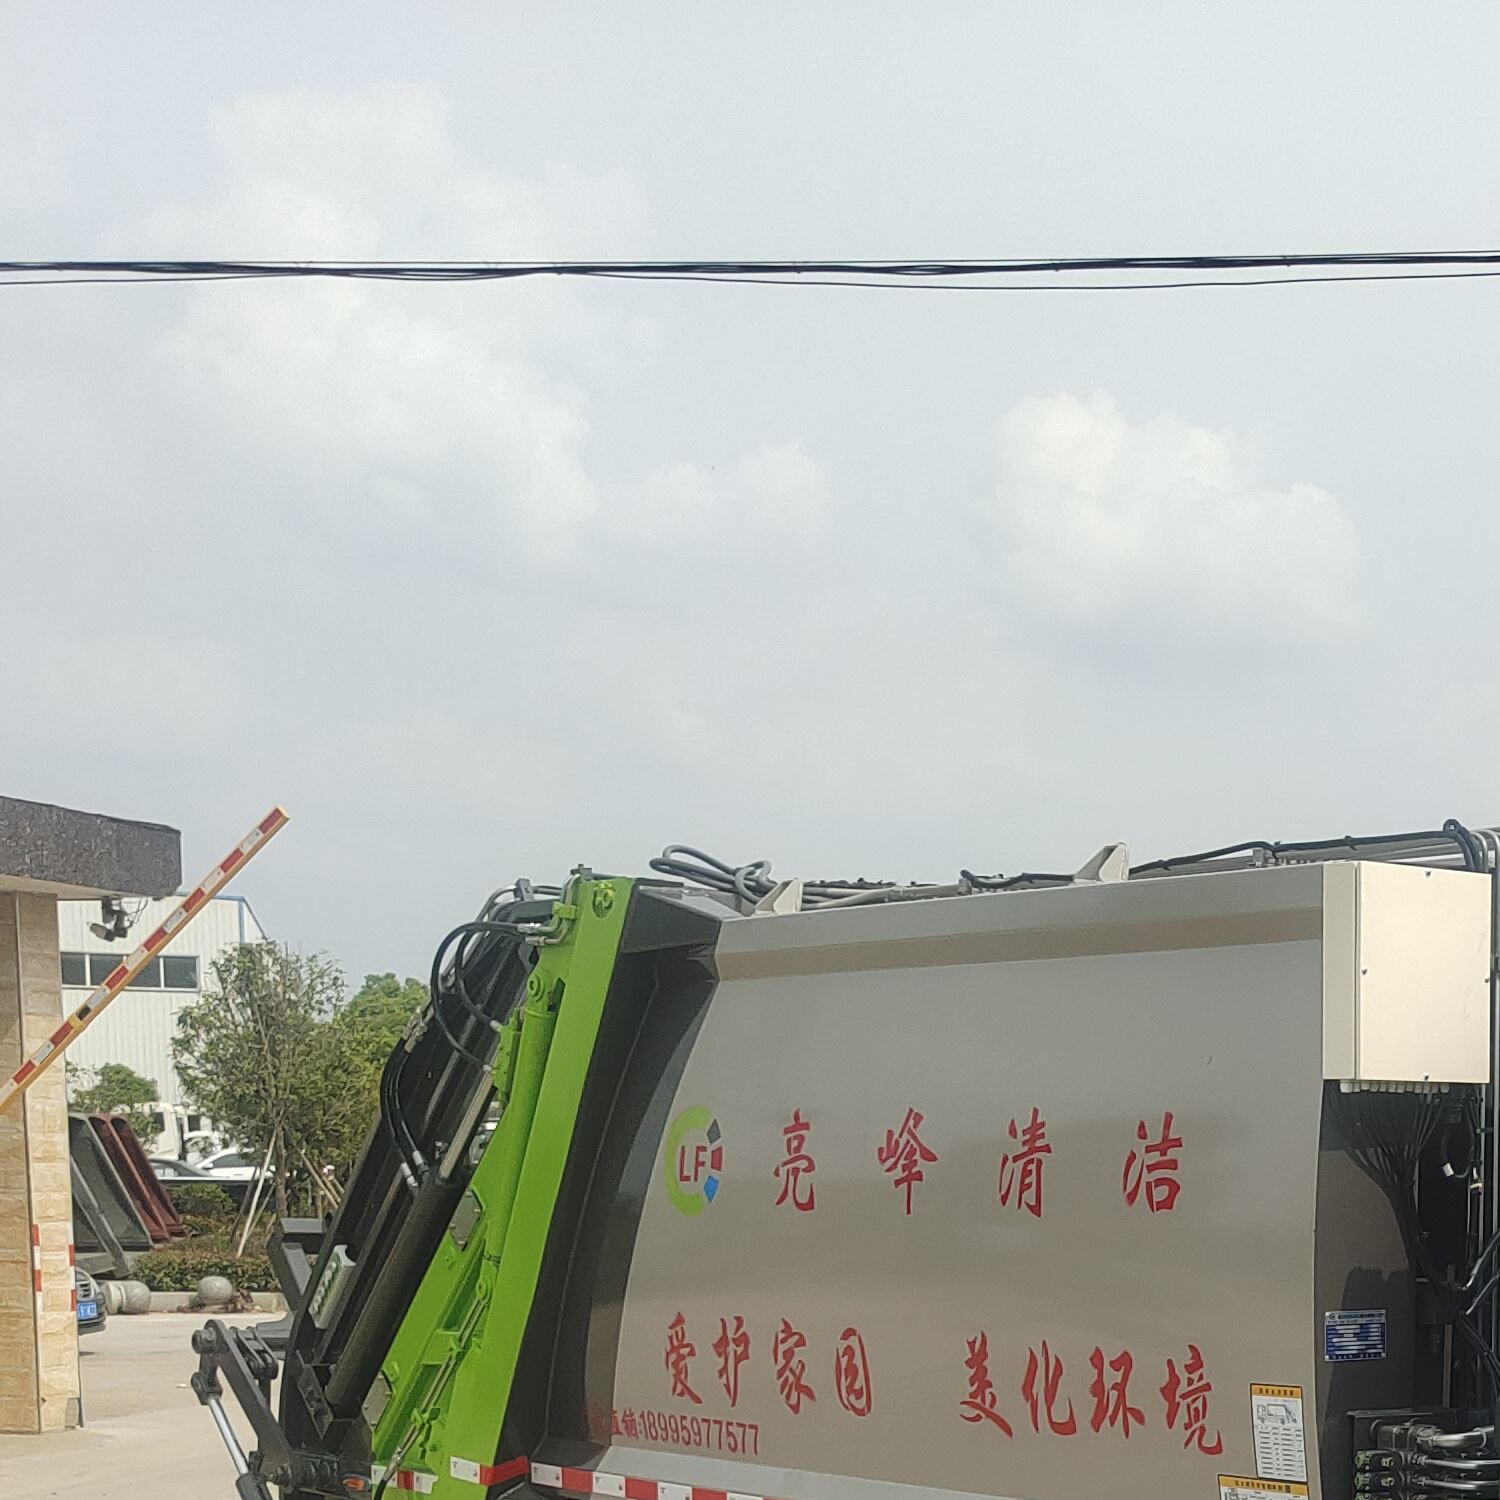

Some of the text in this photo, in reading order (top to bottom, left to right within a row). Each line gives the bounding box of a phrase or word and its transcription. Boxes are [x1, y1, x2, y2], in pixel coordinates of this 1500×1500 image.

[773, 1108, 1184, 1217] 亮峰清洁
[664, 1312, 872, 1416] 爱护家园
[959, 1331, 1223, 1456] 美化环境
